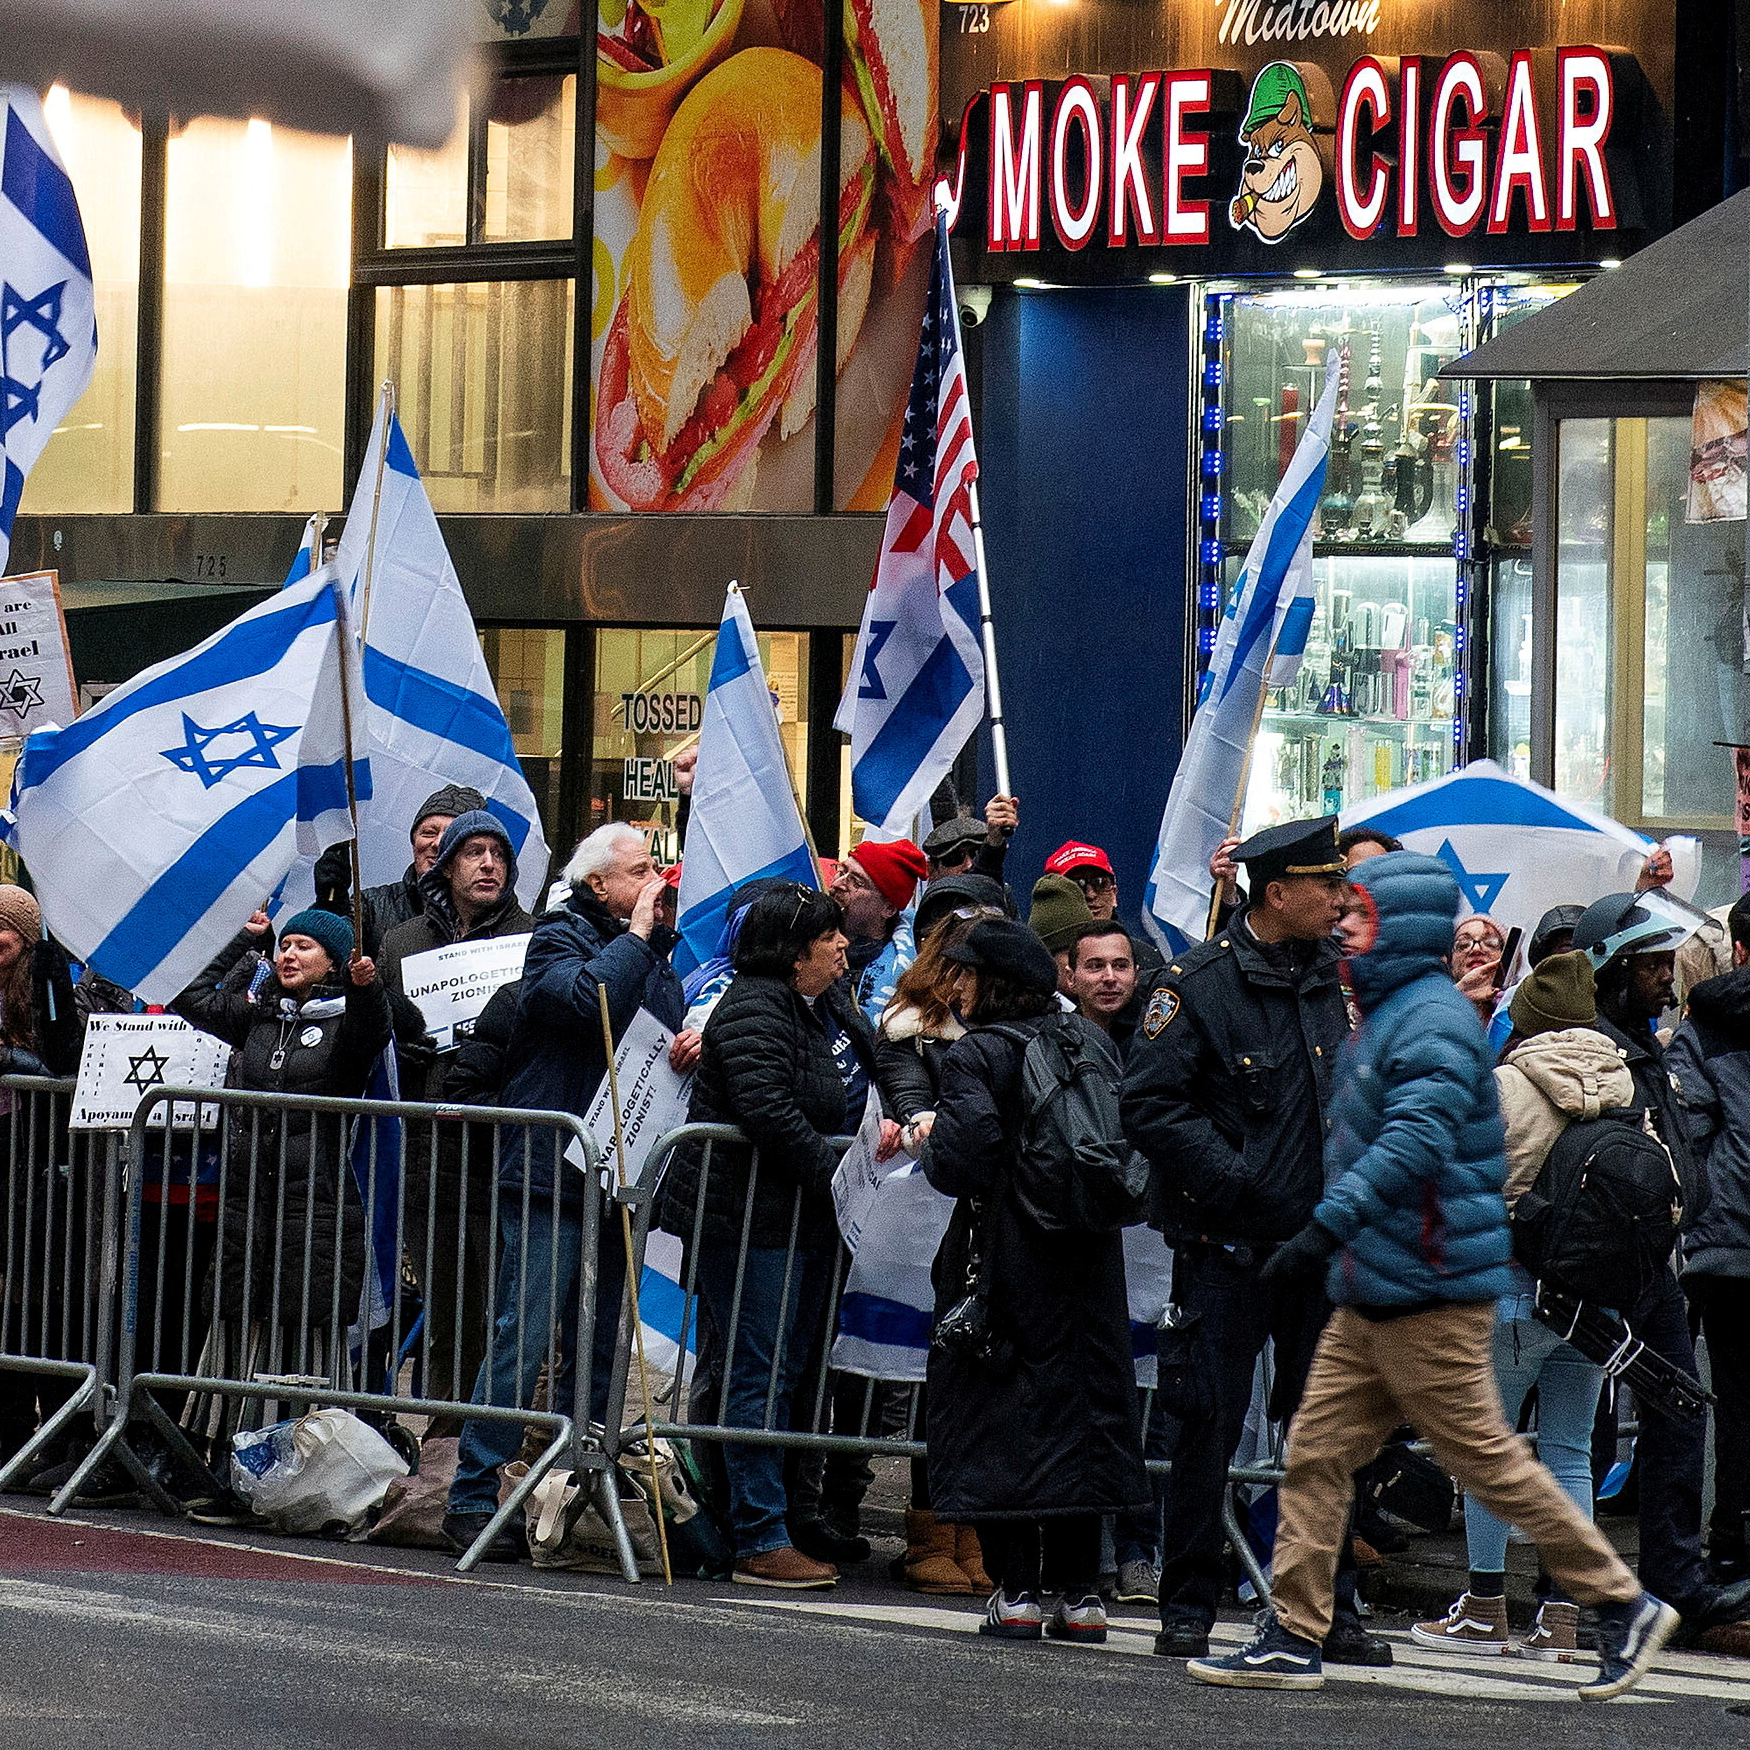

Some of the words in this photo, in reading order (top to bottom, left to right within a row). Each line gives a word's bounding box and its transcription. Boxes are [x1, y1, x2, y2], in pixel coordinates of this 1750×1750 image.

[959, 4, 991, 34] 723
[1334, 45, 1618, 242] CIGAR
[197, 555, 227, 577] 725
[4, 601, 32, 614] are
[621, 693, 702, 731] TOSSED
[624, 758, 681, 799] HEAL
[438, 951, 467, 961] STAND
[470, 946, 493, 954] WITH
[410, 965, 525, 999] UNAPOLOGETIC
[90, 1020, 110, 1031] We
[114, 1020, 154, 1031] Stand
[158, 1019, 188, 1031] with
[588, 1099, 605, 1128] STAND
[624, 1084, 657, 1148] ZIONIST!
